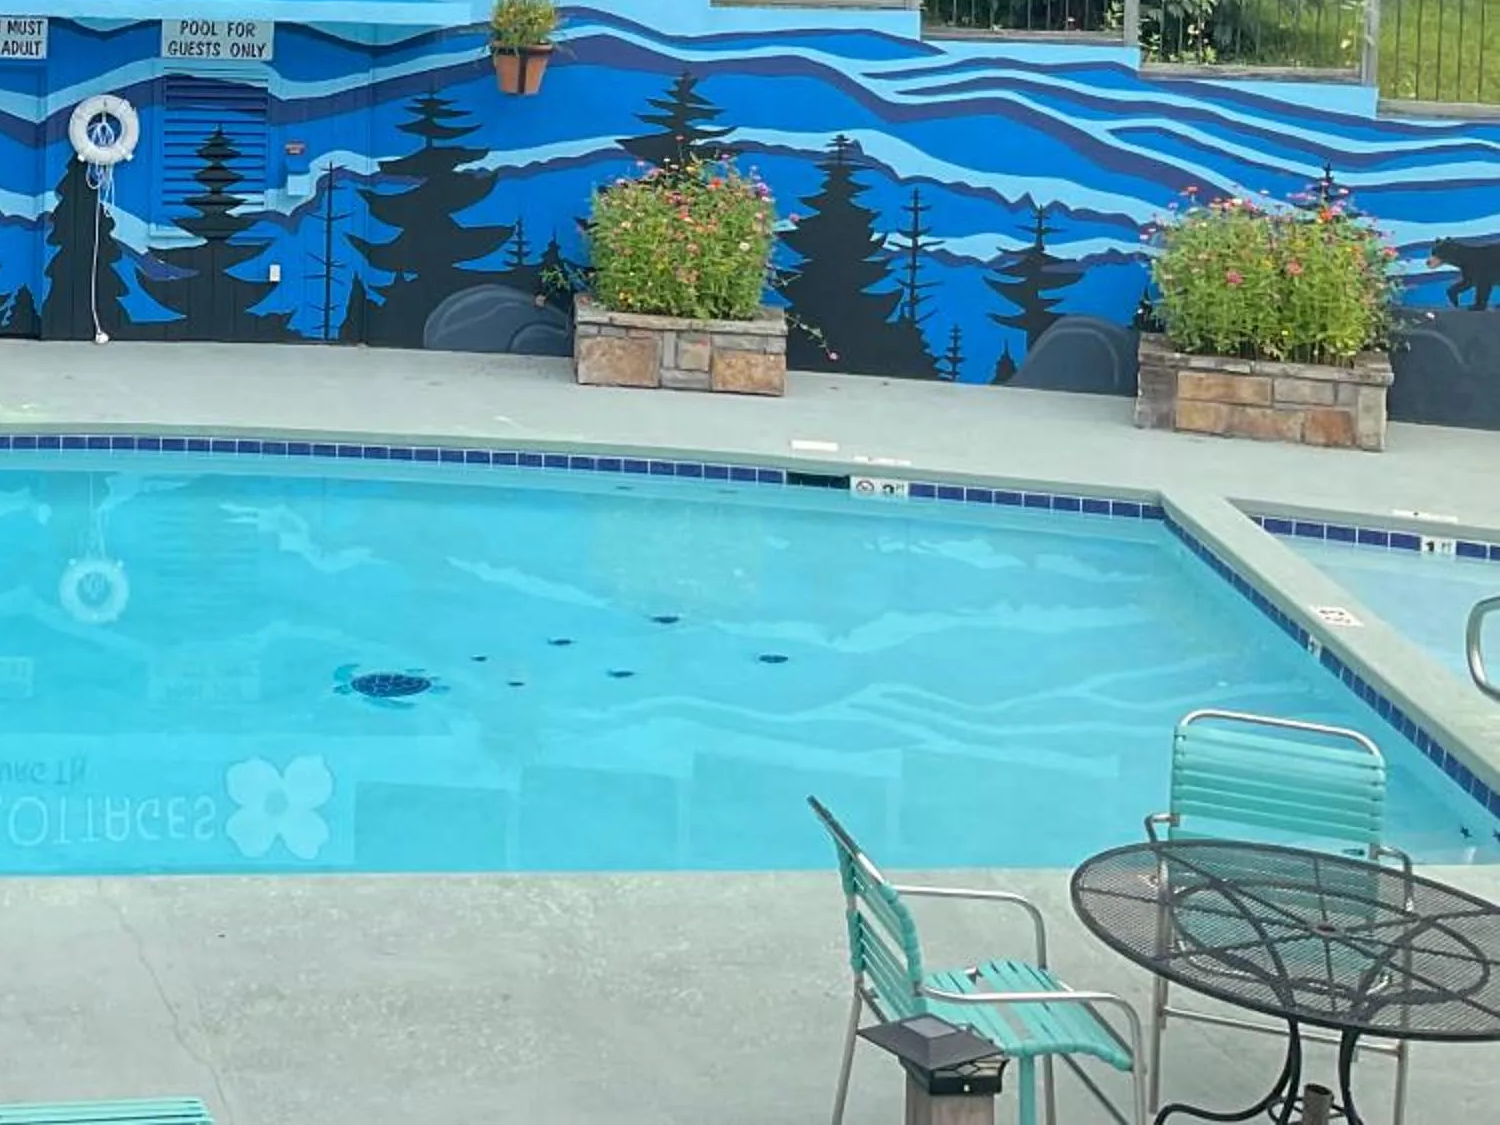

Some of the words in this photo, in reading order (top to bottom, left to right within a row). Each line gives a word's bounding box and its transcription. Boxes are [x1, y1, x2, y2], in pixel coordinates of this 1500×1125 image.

[7, 20, 44, 36] MUST
[180, 20, 219, 36] POOL
[227, 22, 256, 38] FOR
[1, 40, 42, 56] ADULT
[167, 40, 221, 57] GUESTS
[229, 42, 266, 58] ONLY
